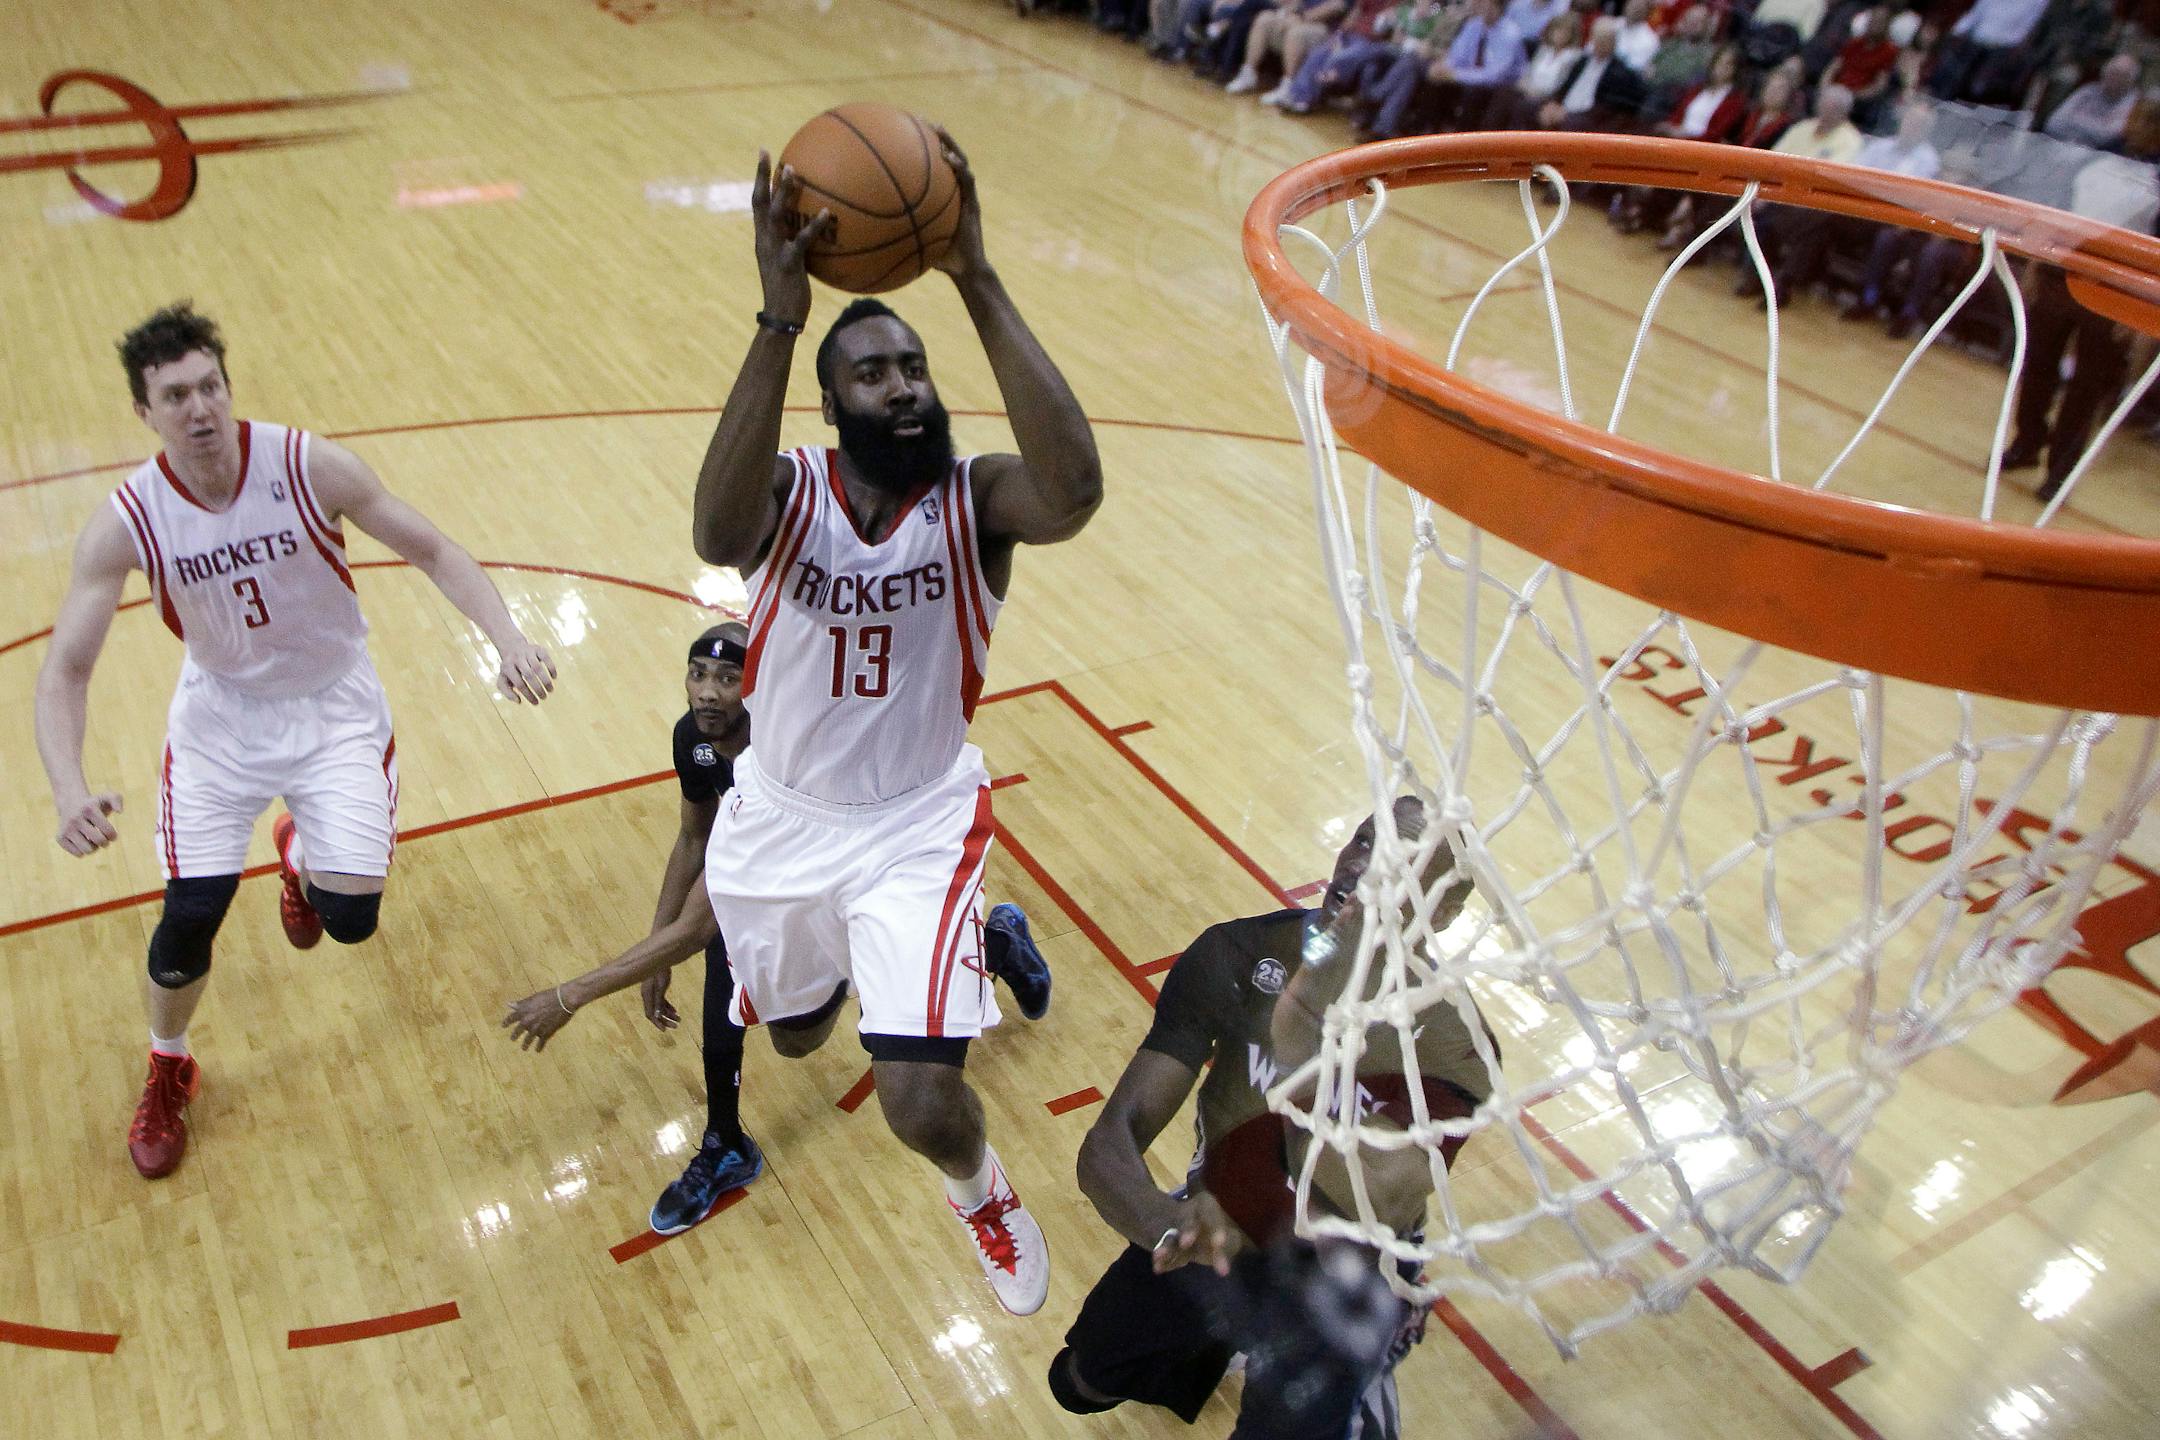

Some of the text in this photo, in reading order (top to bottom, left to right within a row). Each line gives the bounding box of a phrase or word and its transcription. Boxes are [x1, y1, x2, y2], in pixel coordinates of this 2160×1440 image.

[174, 529, 298, 586] ROCKETS
[231, 575, 271, 629] 3
[827, 623, 894, 699] 13
[696, 748, 714, 760] 25
[1257, 963, 1285, 985] 25
